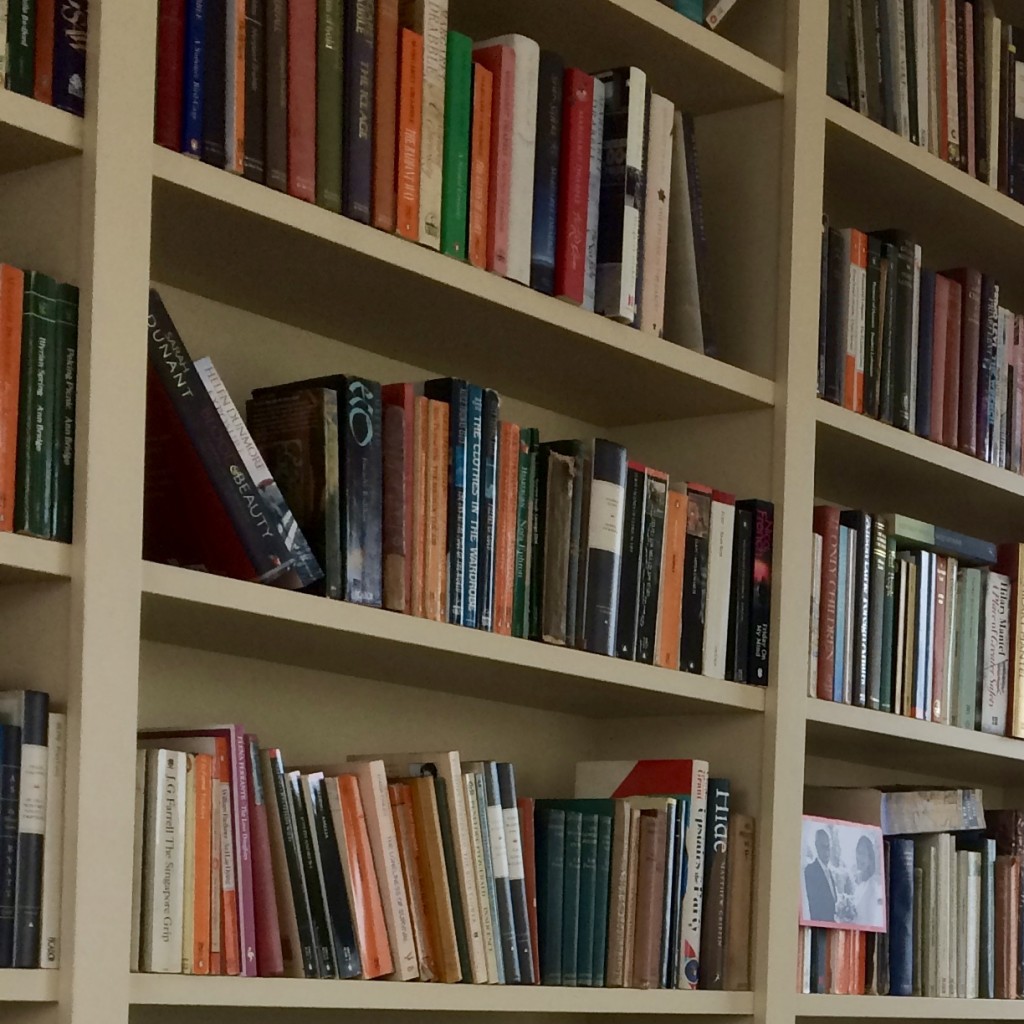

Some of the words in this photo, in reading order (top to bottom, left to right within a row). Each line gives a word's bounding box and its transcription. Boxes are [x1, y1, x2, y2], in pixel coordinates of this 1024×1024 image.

[147, 313, 193, 399] DUNANT
[472, 416, 483, 439] THE
[471, 443, 483, 496] CLOTHES
[232, 474, 274, 538] BEAUTY
[470, 500, 480, 513] IN
[469, 519, 479, 543] THE
[466, 547, 478, 612] WARDROBE
[164, 798, 177, 834] Farrell
[165, 838, 176, 860] The
[160, 864, 174, 913] Singapore
[160, 916, 173, 943] Grip
